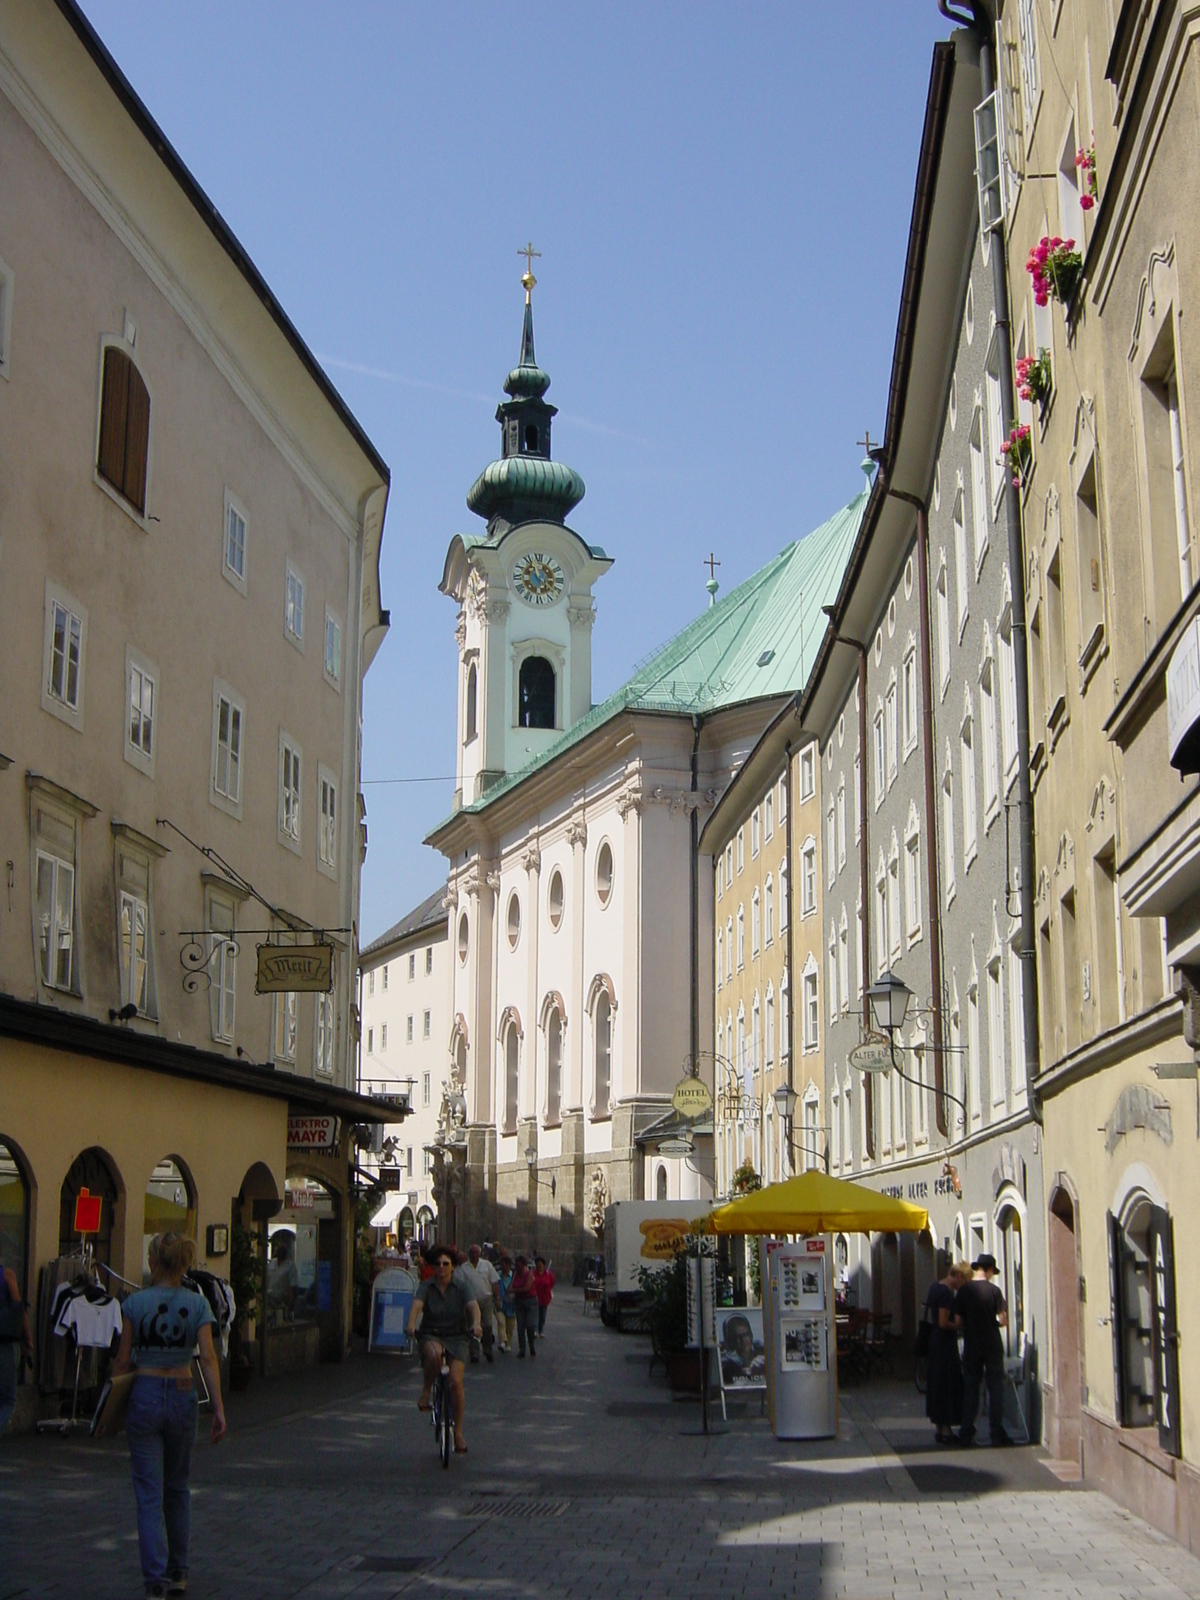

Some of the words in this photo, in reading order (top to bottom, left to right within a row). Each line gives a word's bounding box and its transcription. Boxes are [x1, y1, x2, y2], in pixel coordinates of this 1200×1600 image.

[854, 1050, 875, 1060] ALTER
[878, 1049, 899, 1058] FUCS
[287, 1130, 326, 1142] MAYR
[292, 1190, 314, 1207] Miele
